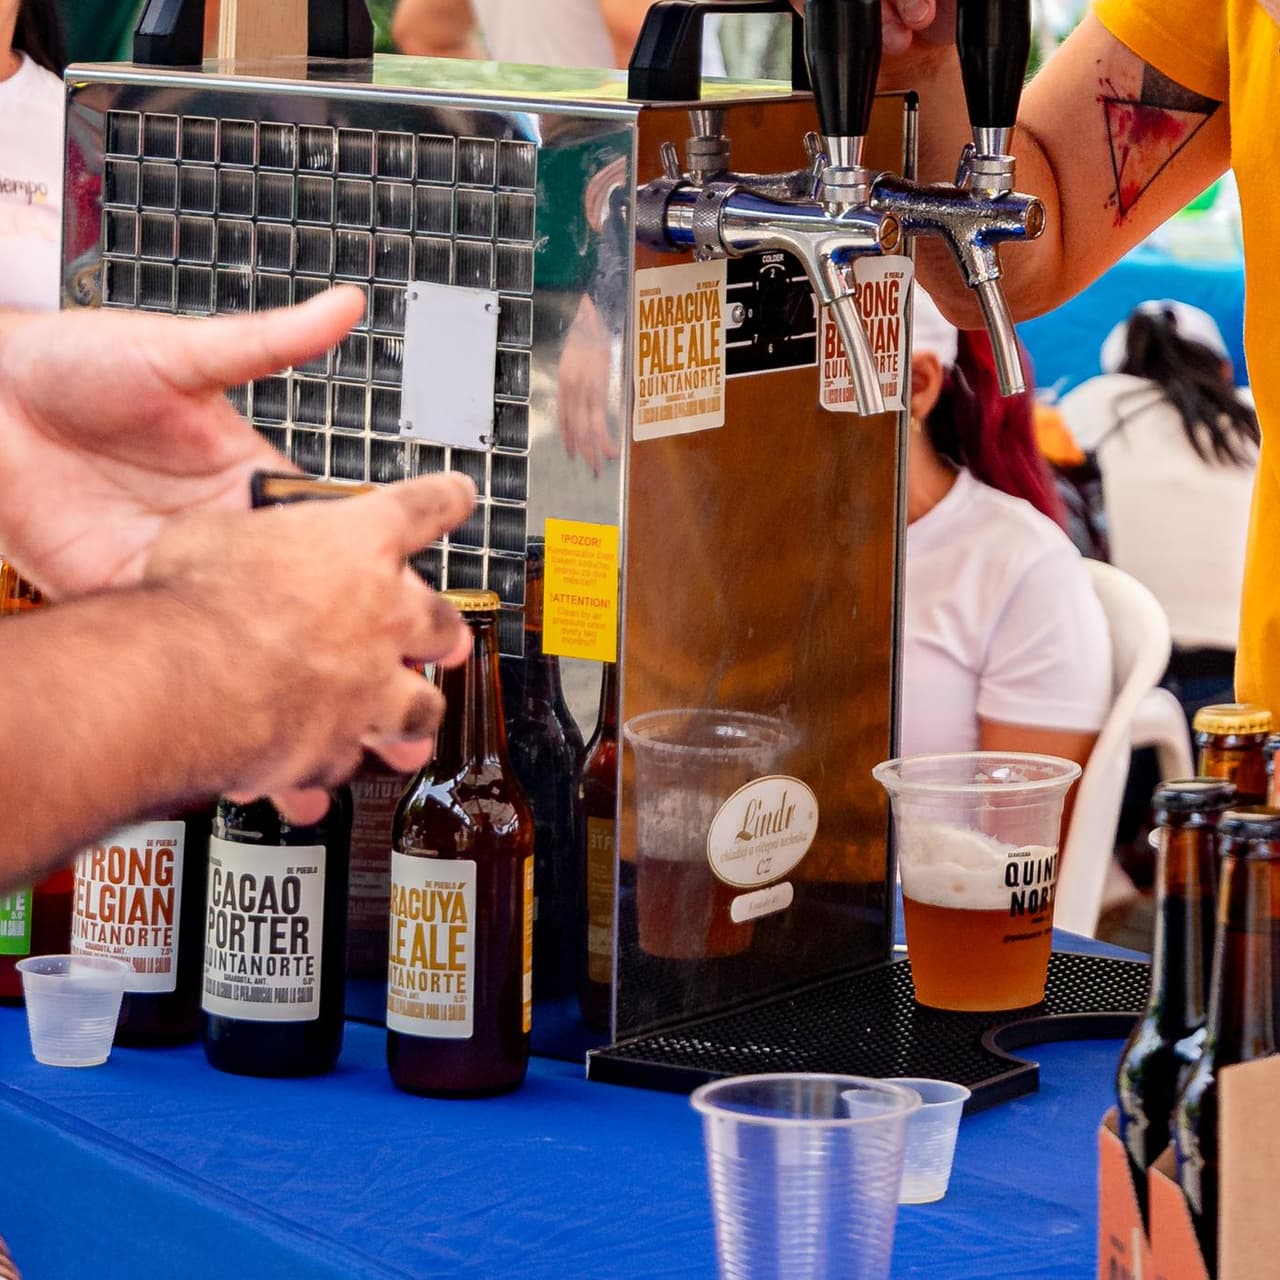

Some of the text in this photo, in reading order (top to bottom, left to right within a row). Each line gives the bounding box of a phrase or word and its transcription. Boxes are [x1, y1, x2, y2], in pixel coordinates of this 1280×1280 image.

[762, 253, 785, 264] COLDER
[770, 268, 776, 278] 2
[639, 320, 721, 378] PALE ALE
[825, 317, 901, 360] BEIAN
[639, 366, 721, 399] QUINTANORTE
[825, 353, 899, 380] QUINRTE
[735, 790, 797, 842] Lindr
[74, 845, 175, 887] TRONG
[756, 857, 774, 876] CZ
[74, 877, 175, 927] ELGIAN
[212, 867, 301, 915] CACAO
[207, 906, 310, 955] PORTER
[410, 922, 468, 972] ALE
[205, 948, 315, 977] UINTANORTE
